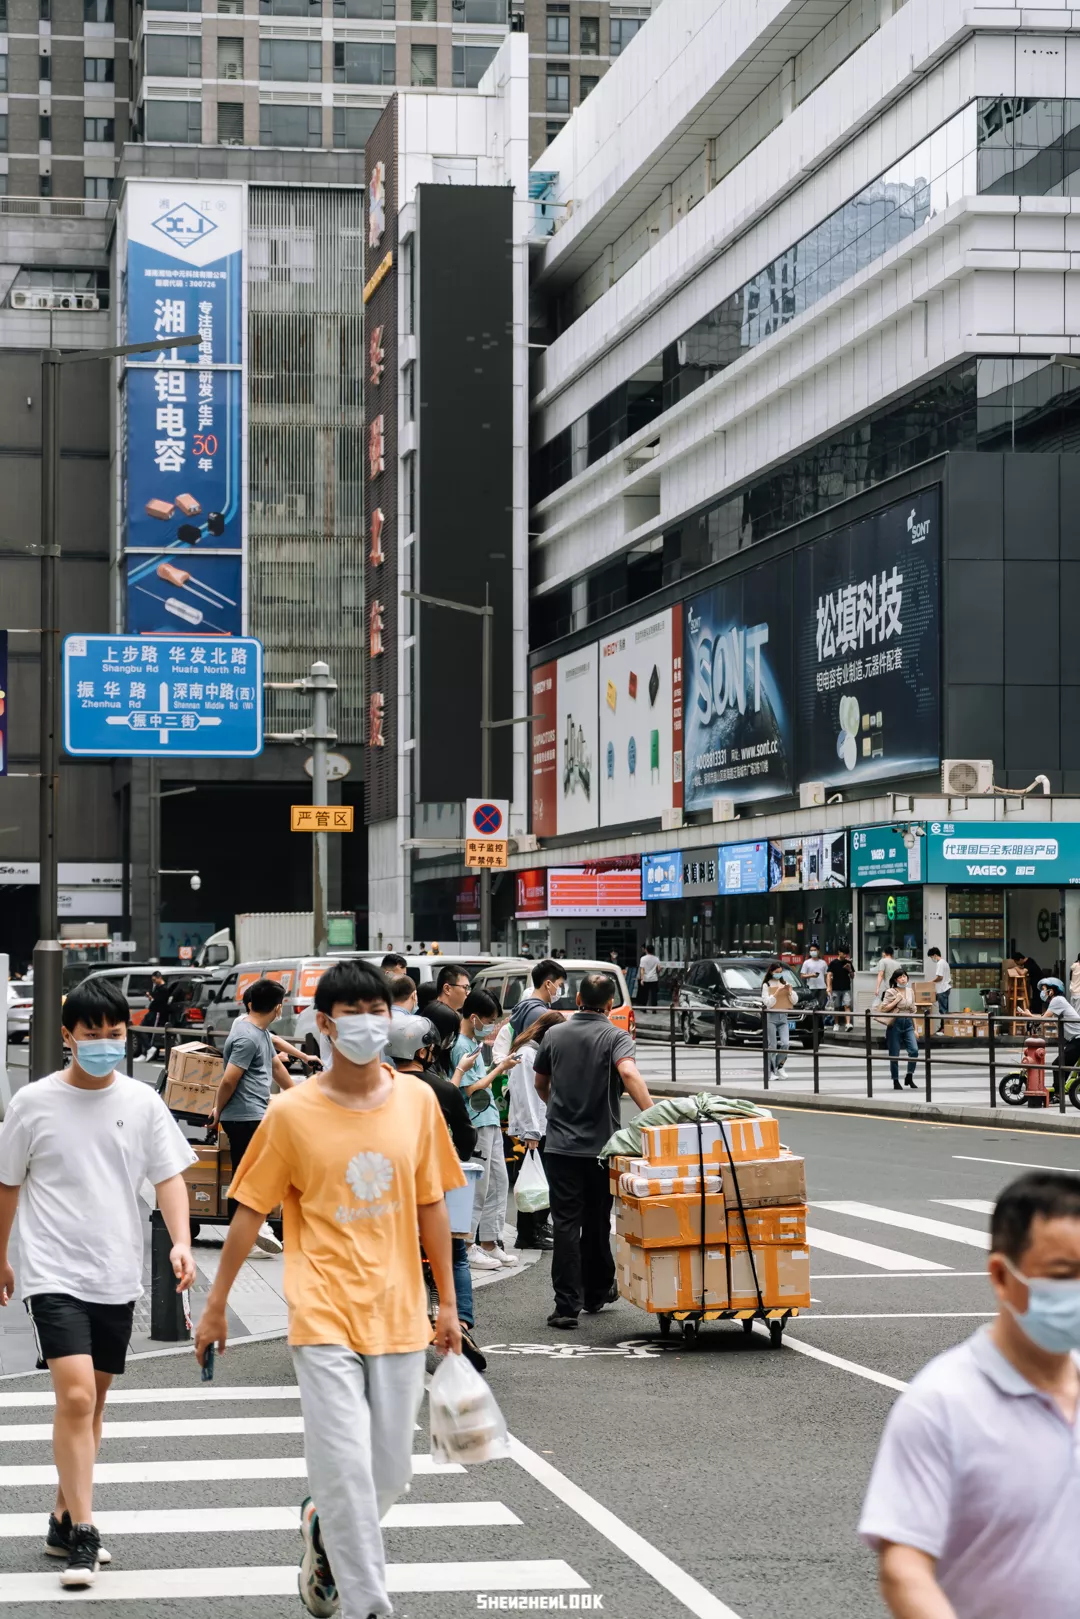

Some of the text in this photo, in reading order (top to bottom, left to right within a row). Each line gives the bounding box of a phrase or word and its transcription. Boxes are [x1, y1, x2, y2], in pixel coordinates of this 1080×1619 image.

[912, 520, 930, 540] SONT
[816, 566, 903, 662] 松填科技
[102, 646, 158, 664] 上步路
[169, 646, 248, 665] 华发北路
[102, 664, 159, 674] Shangbu Rd
[172, 665, 246, 674] Huafa North Rd
[697, 622, 769, 725] SONT
[77, 681, 146, 699] 振华路
[82, 700, 141, 708] Zhenhua Rd
[173, 701, 200, 709] Shennan
[205, 701, 224, 709] Middle
[133, 714, 195, 729] 振中二街
[741, 740, 778, 761] www.sont.cc
[297, 811, 347, 826] 严管区
[469, 843, 503, 852] 电子监控
[469, 856, 503, 865] 严禁停车
[966, 865, 1007, 876] YAGEO
[1015, 866, 1036, 876] 国巨
